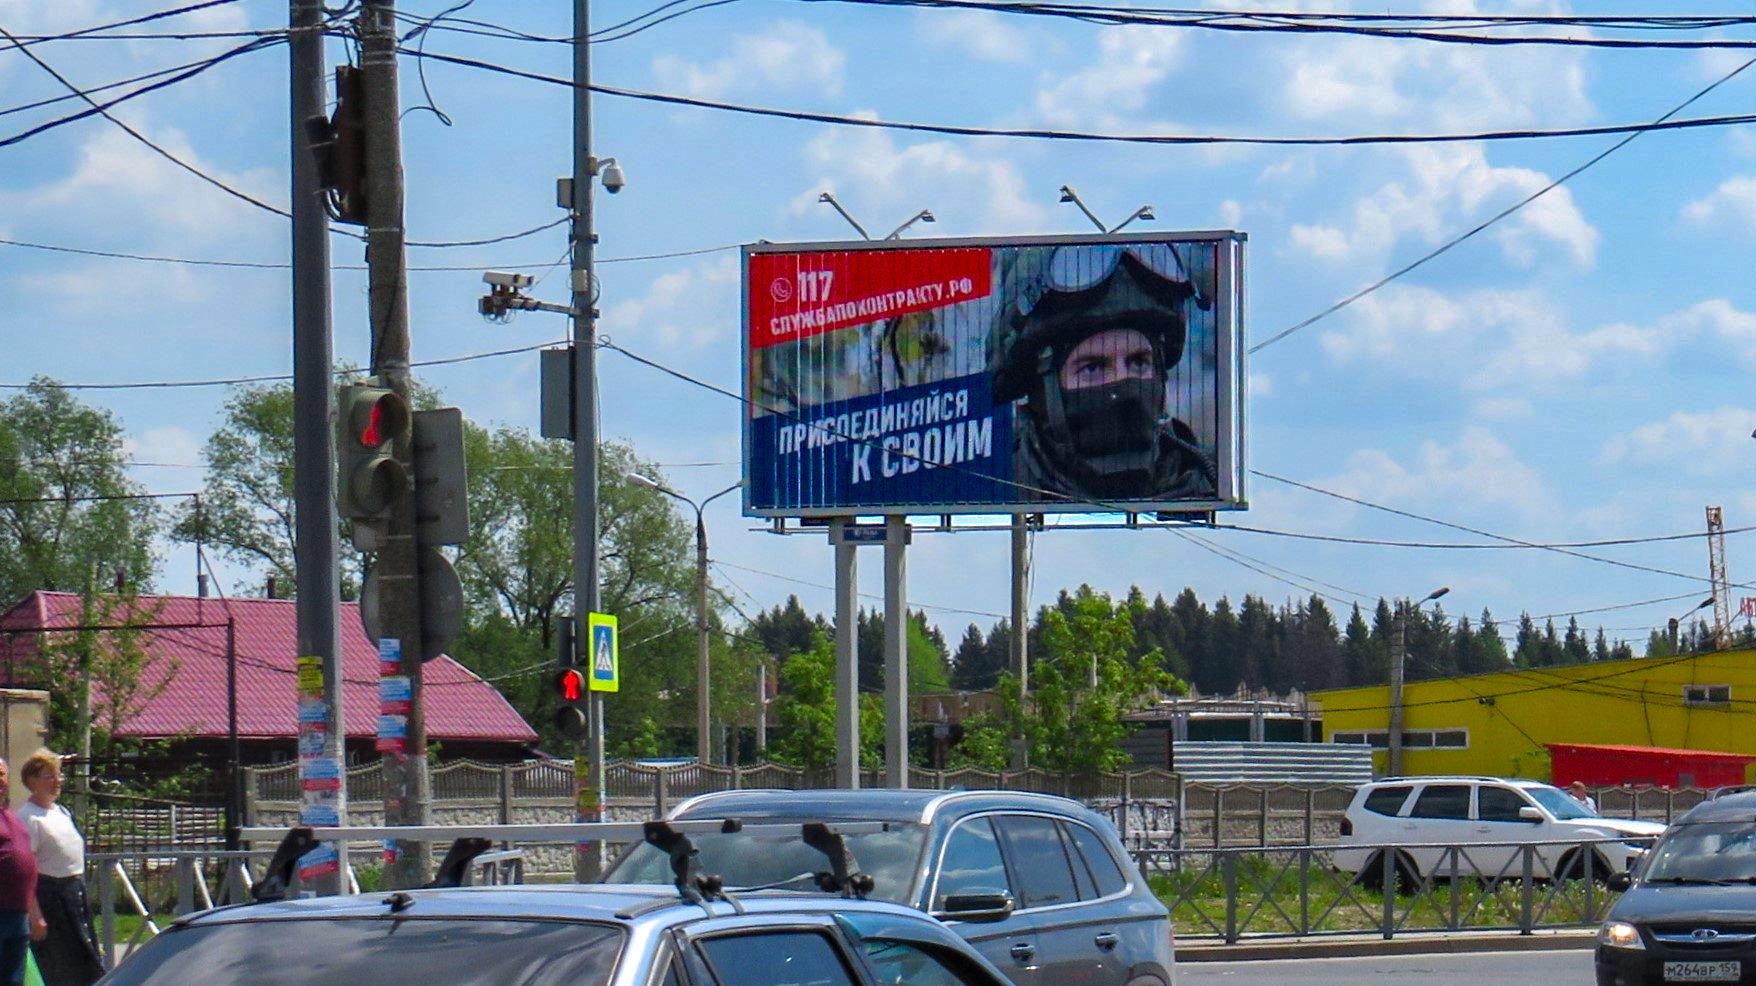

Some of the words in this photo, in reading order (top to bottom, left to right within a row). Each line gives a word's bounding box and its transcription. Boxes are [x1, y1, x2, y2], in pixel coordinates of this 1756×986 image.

[769, 278, 973, 336] СЛУЖБАПОКОНТРАКТУ.РФ
[799, 270, 834, 302] 117
[779, 389, 969, 455] ПРИСОЕДИНЯЙСЯ
[852, 443, 873, 485] К
[881, 416, 993, 479] СВОИМ
